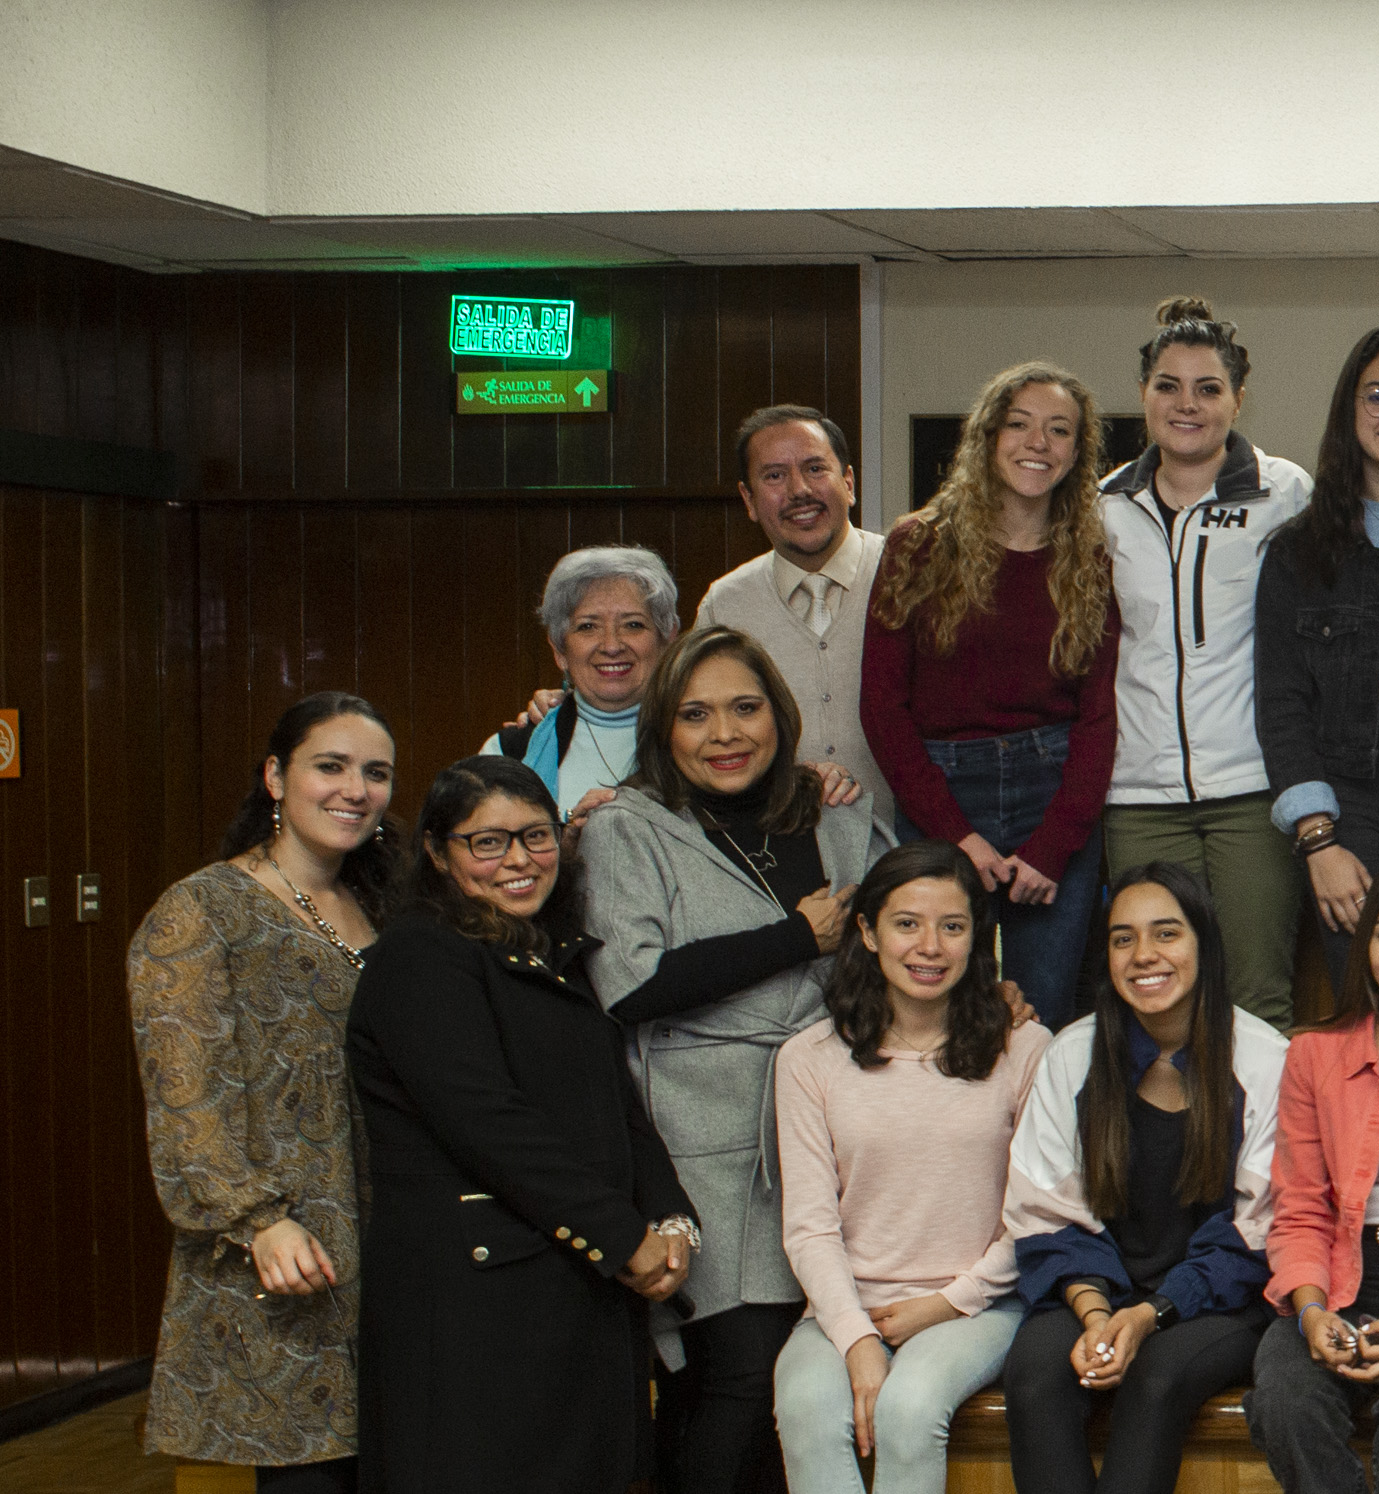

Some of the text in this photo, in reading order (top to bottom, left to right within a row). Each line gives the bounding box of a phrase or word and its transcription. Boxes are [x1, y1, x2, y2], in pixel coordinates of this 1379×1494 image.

[456, 303, 569, 331] SALIDA DE
[455, 325, 568, 356] EMERGENCIA
[498, 380, 552, 391] SALIDA DE
[498, 393, 566, 405] EMERGENCIA
